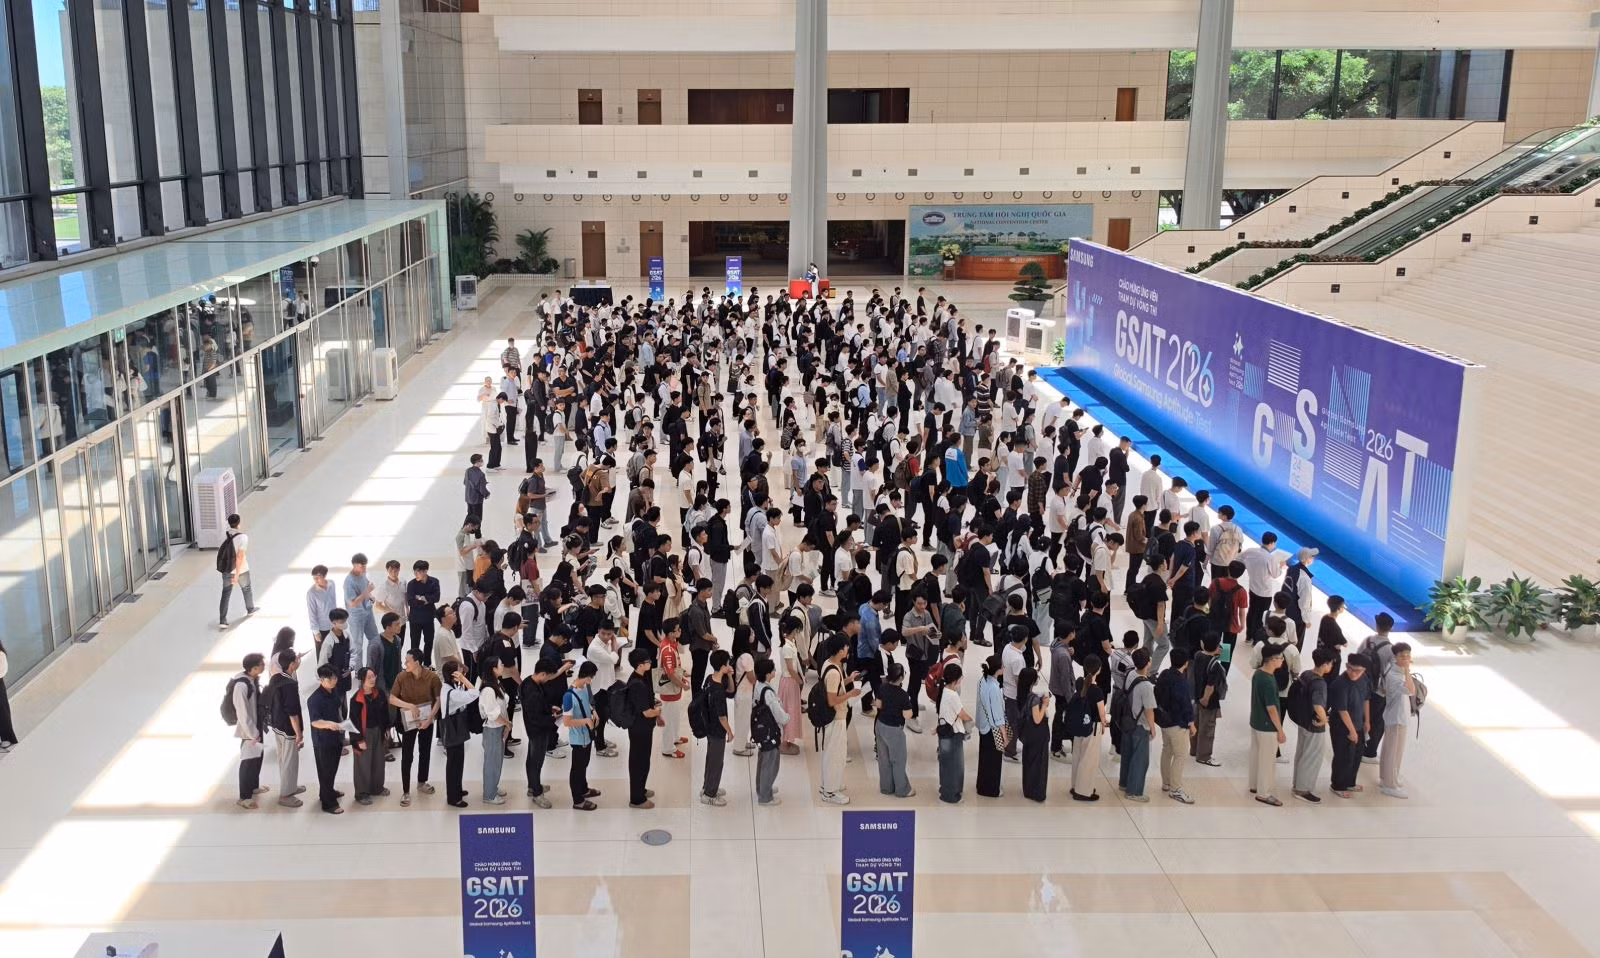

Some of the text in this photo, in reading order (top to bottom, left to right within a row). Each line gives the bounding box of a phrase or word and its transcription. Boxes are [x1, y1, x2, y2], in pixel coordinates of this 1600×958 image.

[1070, 248, 1093, 268] SAMSUNG
[1115, 310, 1215, 408] GSAT 2026
[1114, 364, 1133, 388] Global
[1134, 374, 1163, 409] Samsung
[1366, 429, 1394, 461] 2026
[466, 876, 528, 896] GSAT
[847, 872, 908, 892] GSAT
[474, 898, 522, 918] 2026
[853, 894, 900, 914] 2026
